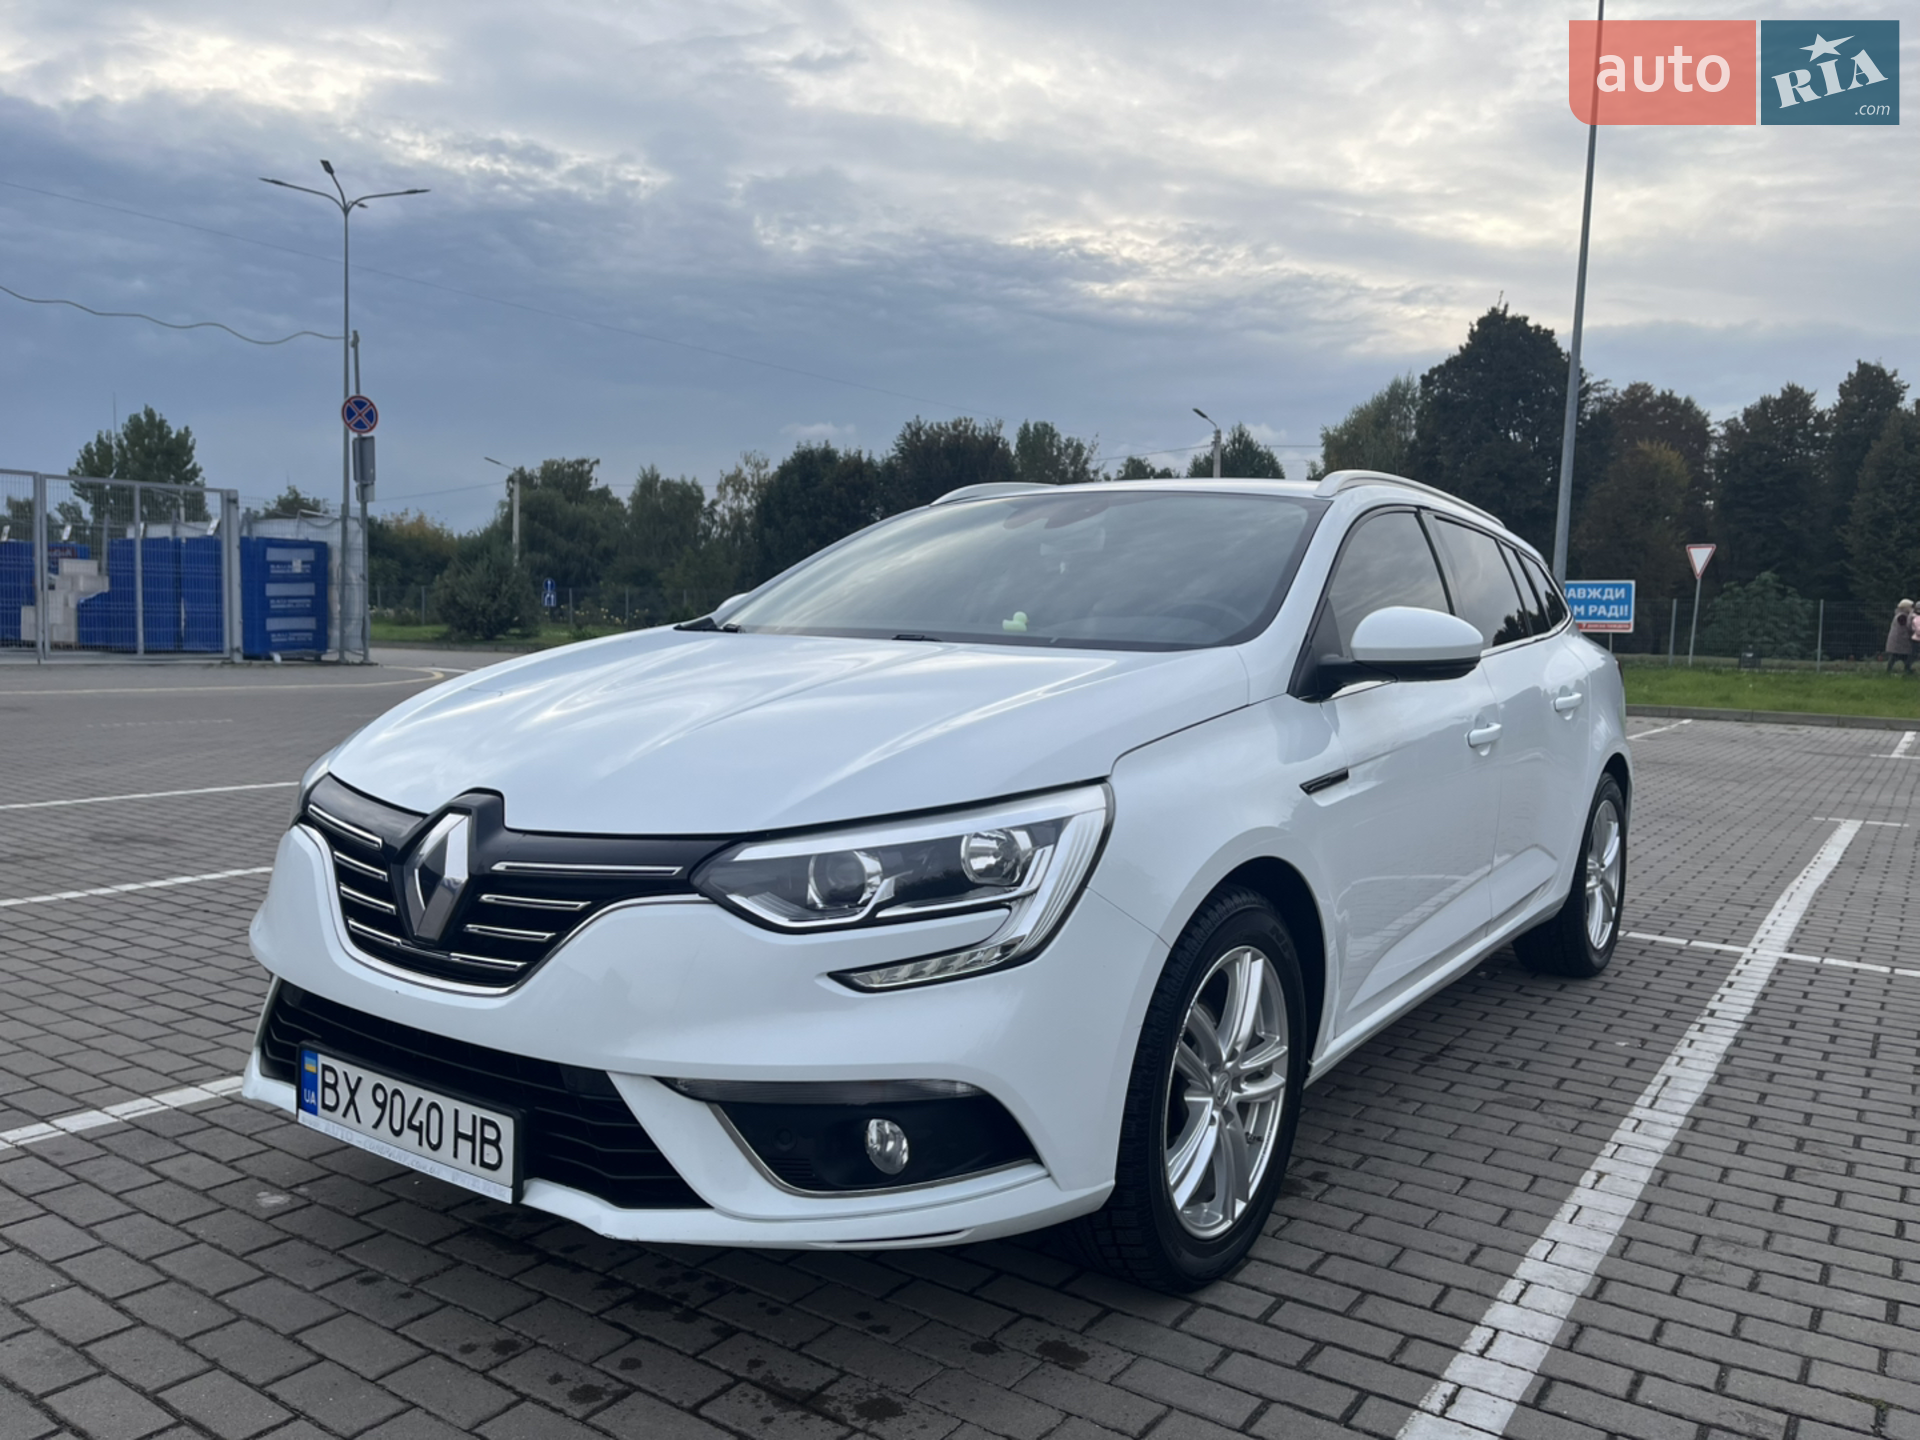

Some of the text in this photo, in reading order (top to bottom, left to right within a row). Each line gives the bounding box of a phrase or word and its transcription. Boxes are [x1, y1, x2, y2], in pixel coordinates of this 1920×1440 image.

[1588, 604, 1629, 618] РАДІ!
[303, 1087, 317, 1106] UA
[321, 1063, 504, 1171] BX 9040 HB
